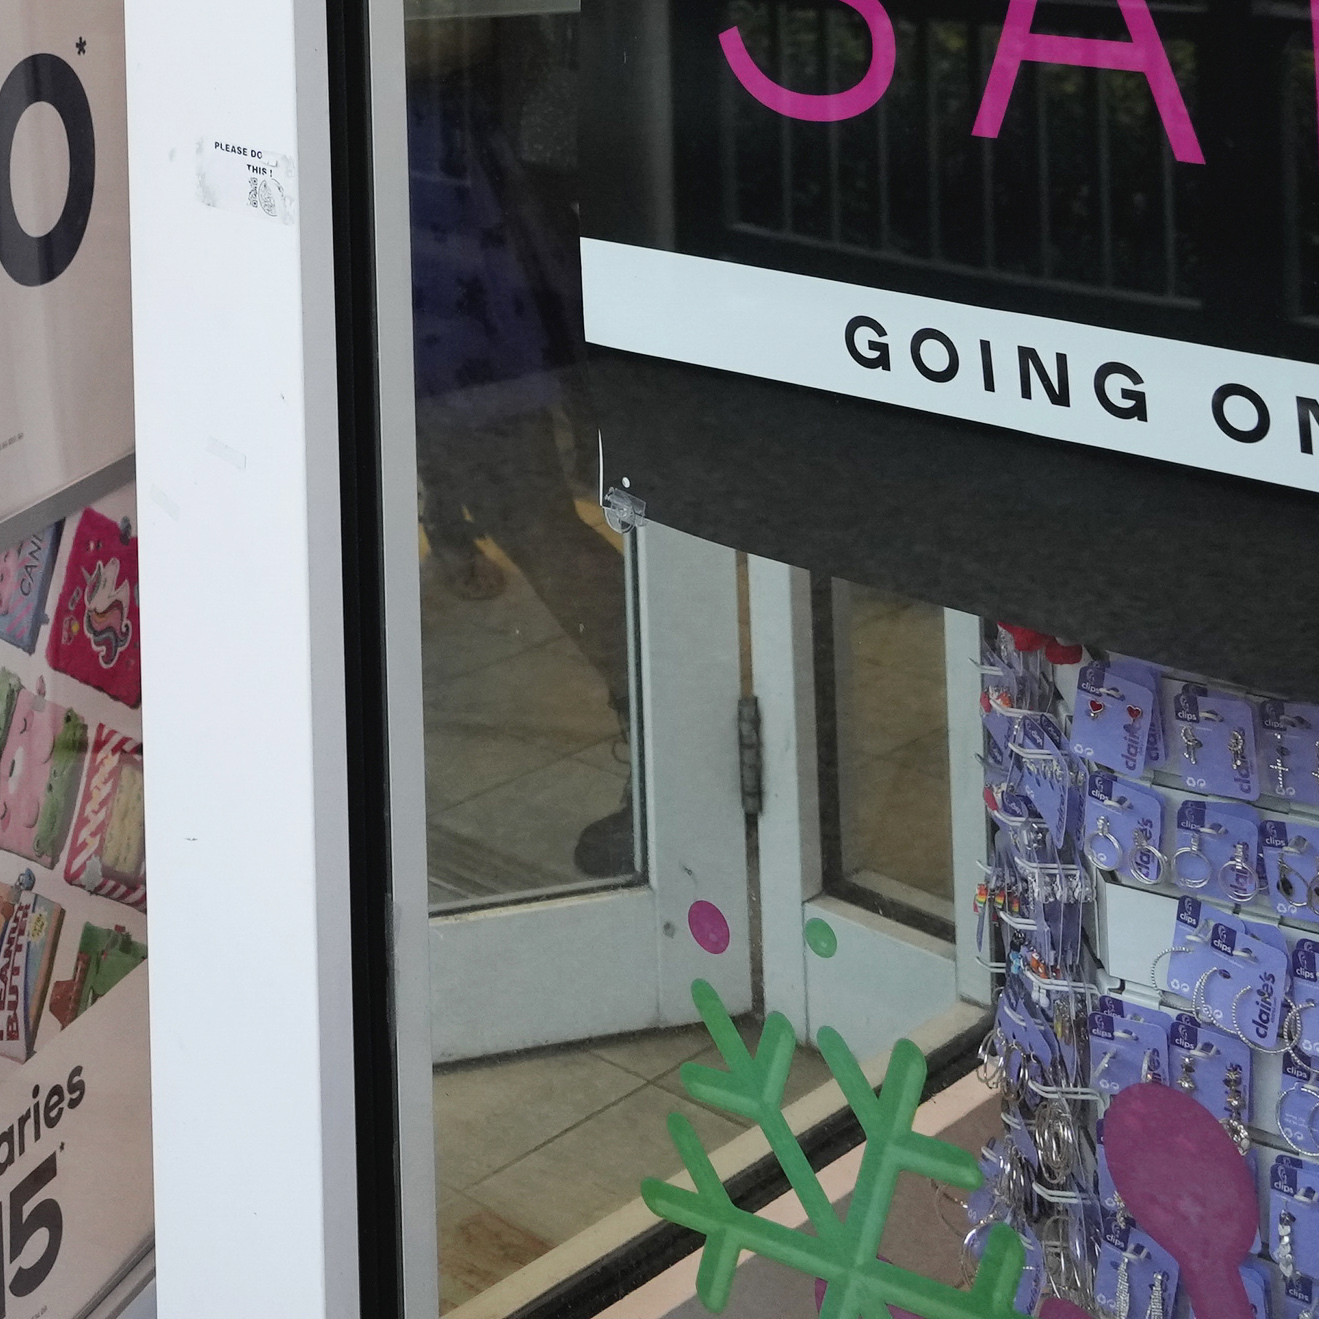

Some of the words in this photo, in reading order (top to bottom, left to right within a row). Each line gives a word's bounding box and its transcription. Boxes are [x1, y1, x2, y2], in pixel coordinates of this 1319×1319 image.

[214, 141, 248, 156] PLEASE
[247, 164, 267, 175] THIS
[844, 314, 1148, 423] GOING
[21, 535, 42, 596] CAN
[1177, 710, 1197, 721] clips
[1265, 837, 1285, 848] clips
[1179, 912, 1197, 926] clips
[1213, 939, 1232, 954] clips
[1295, 967, 1316, 979] clips
[1092, 1027, 1112, 1038] clips
[1175, 1037, 1195, 1051] clips
[1286, 1066, 1308, 1079] clips
[1273, 1182, 1295, 1195] clips
[1106, 1233, 1126, 1248] clips
[1288, 1289, 1309, 1301] clips
